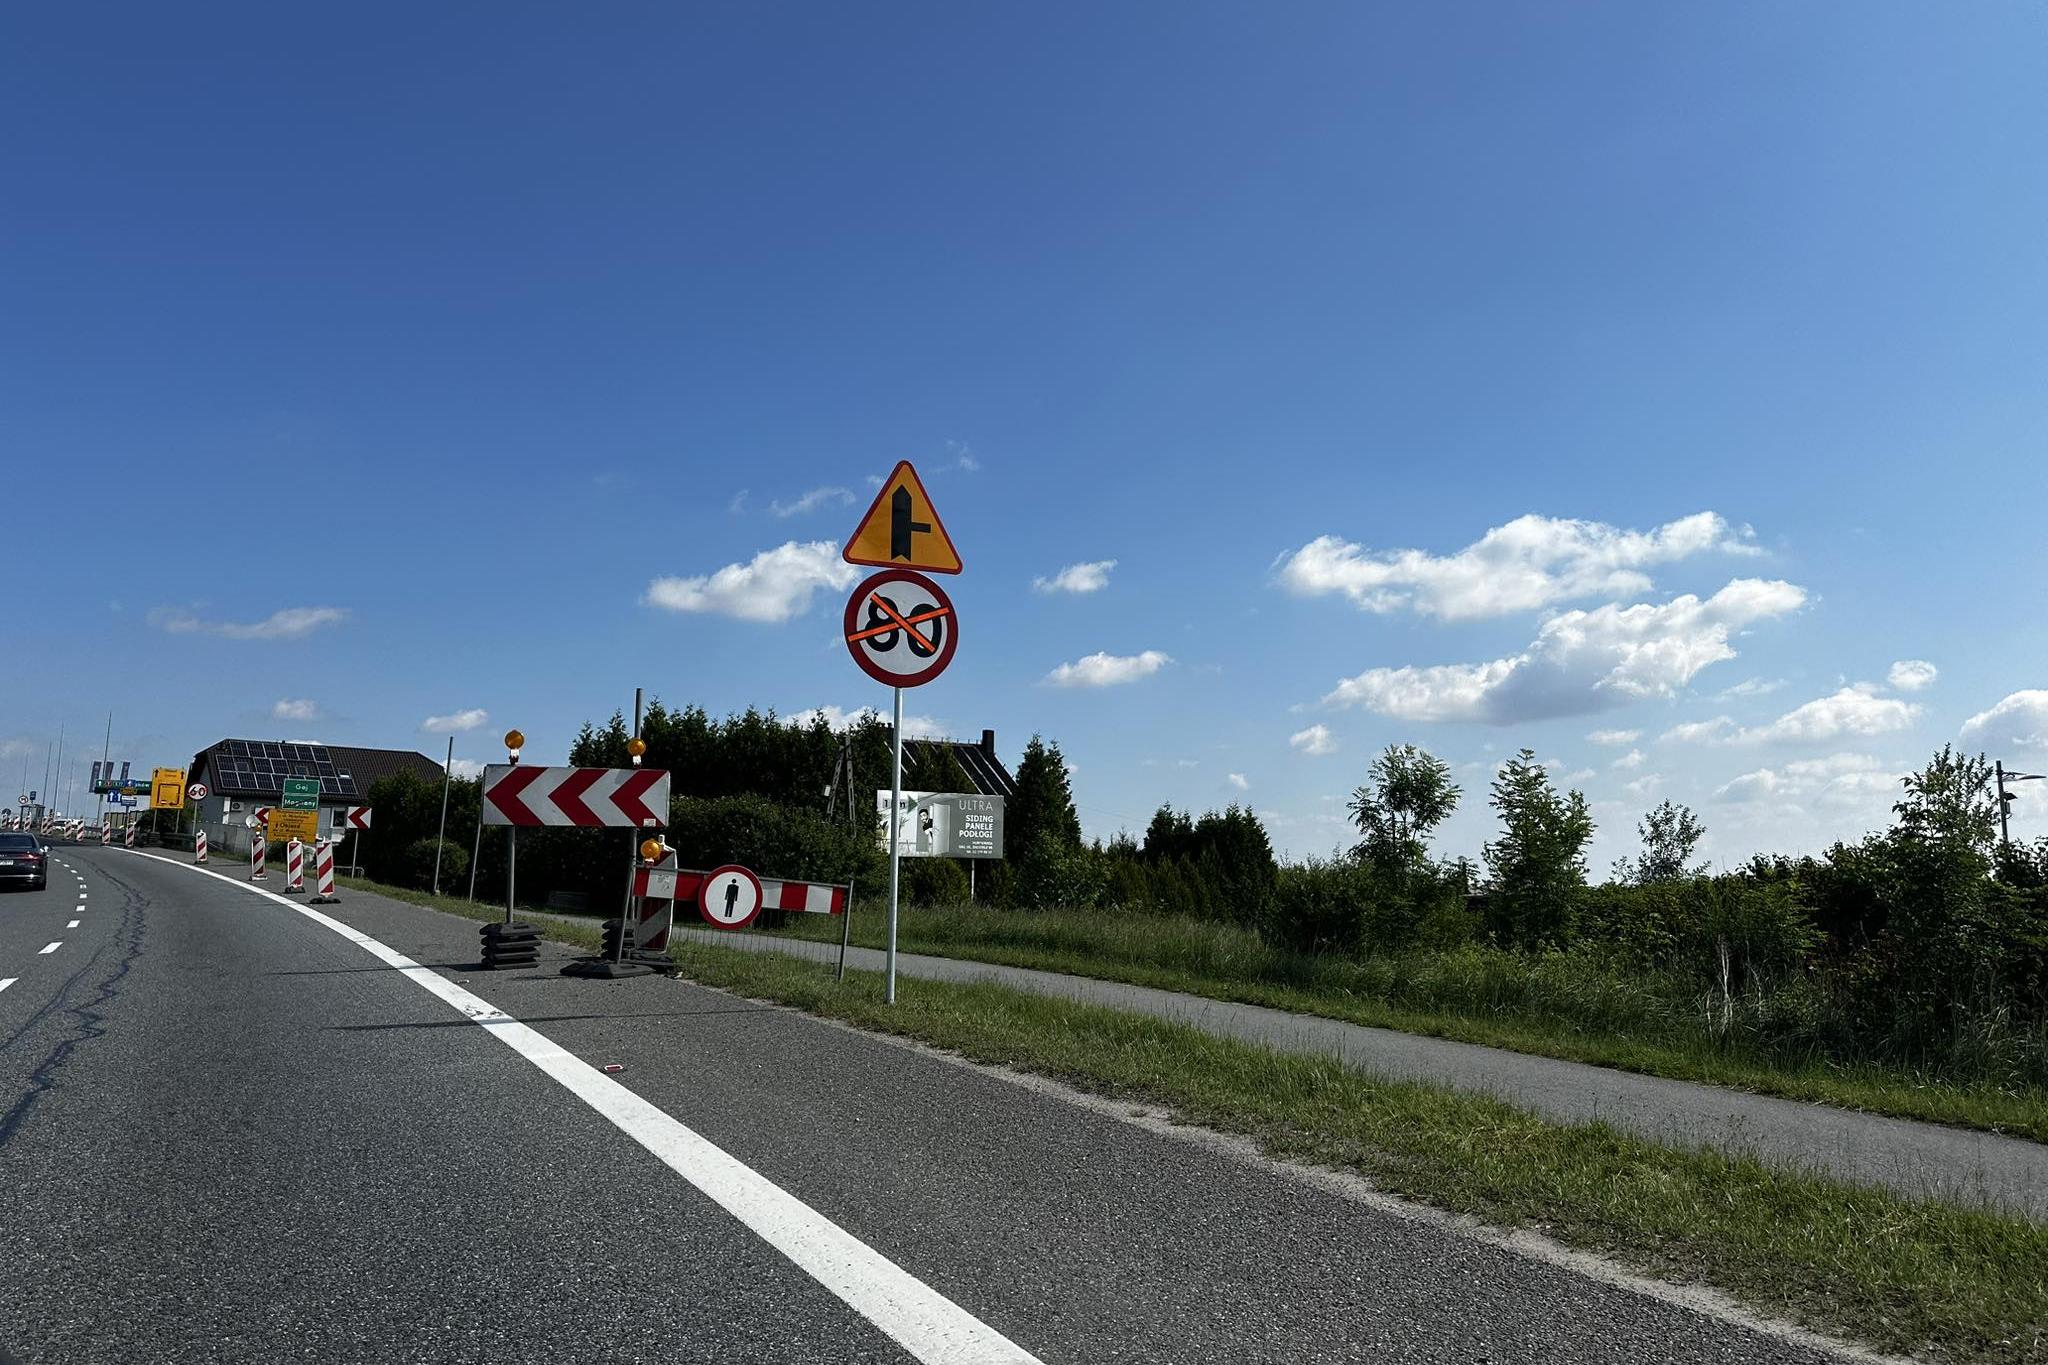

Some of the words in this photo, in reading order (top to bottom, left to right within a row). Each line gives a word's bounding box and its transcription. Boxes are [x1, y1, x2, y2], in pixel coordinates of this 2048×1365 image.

[865, 596, 942, 658] 80
[959, 800, 993, 811] ULTRA
[965, 815, 994, 823] SIDING
[965, 822, 993, 831] PANELE
[959, 830, 993, 838] PODŁOGI
